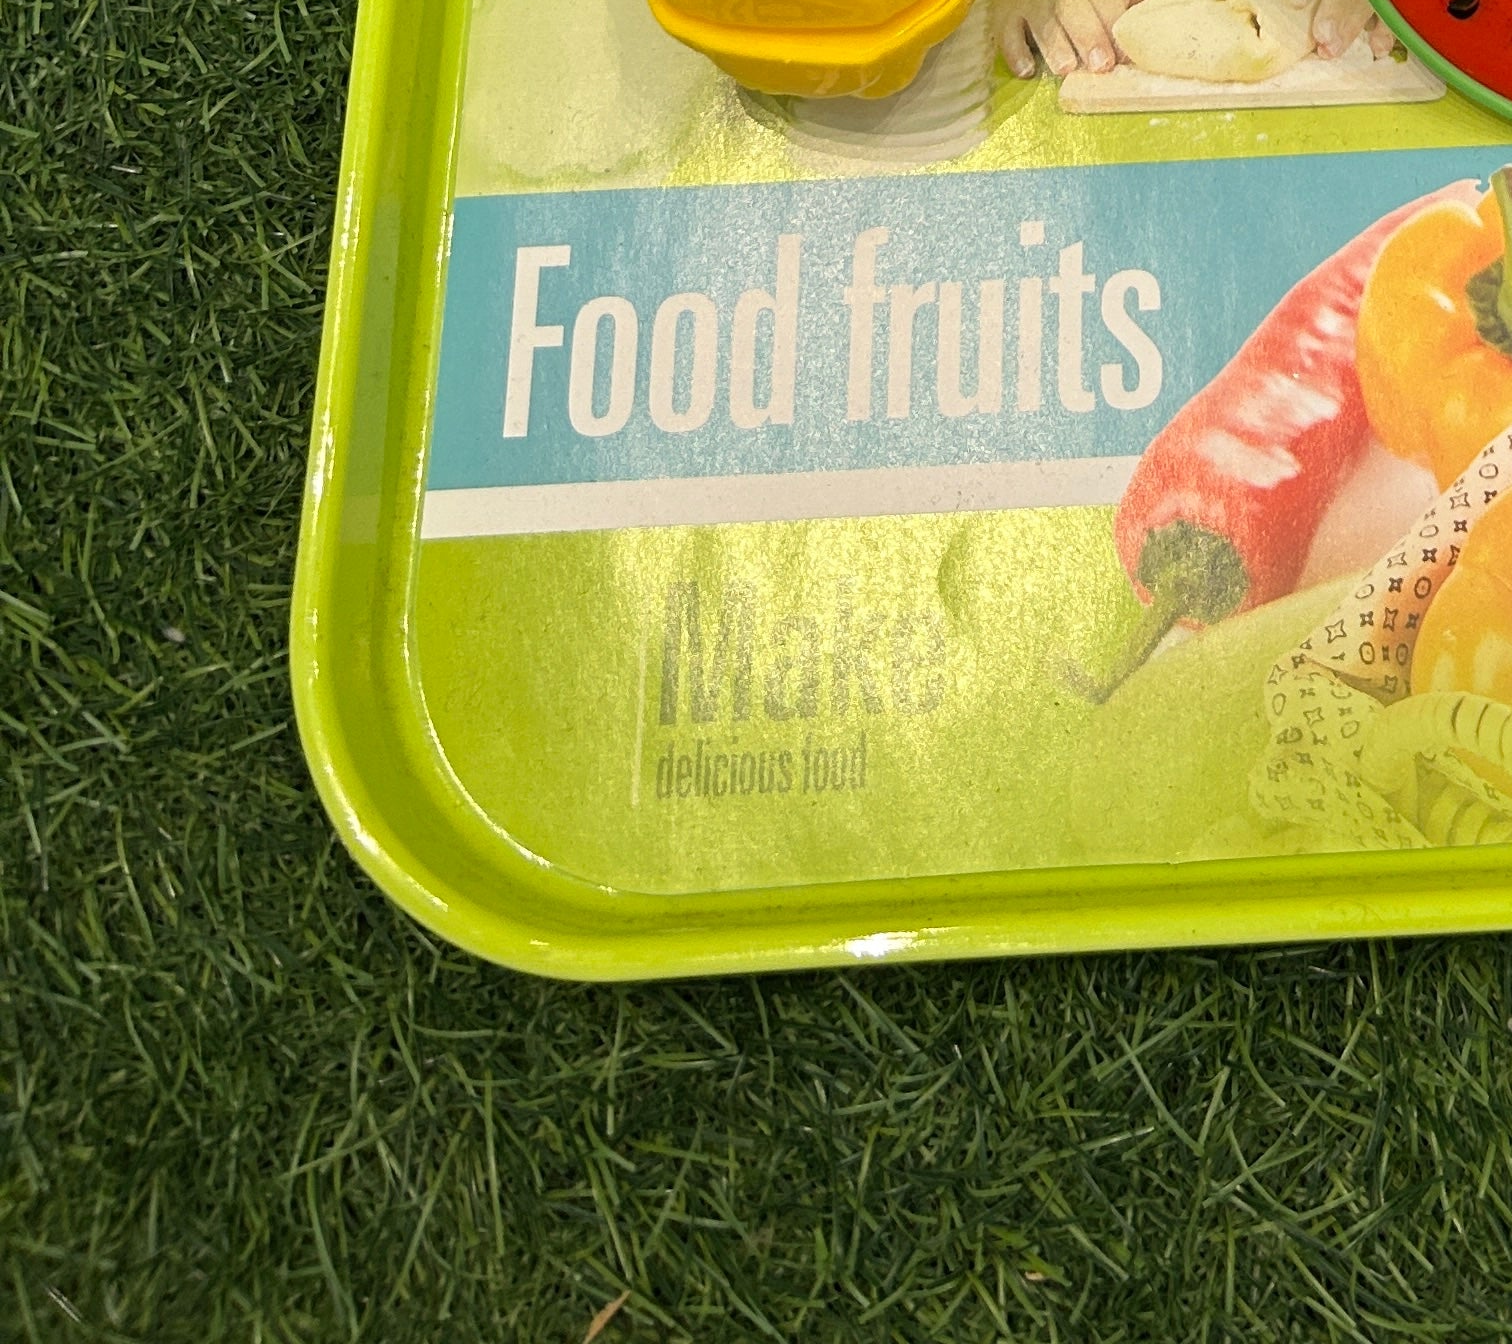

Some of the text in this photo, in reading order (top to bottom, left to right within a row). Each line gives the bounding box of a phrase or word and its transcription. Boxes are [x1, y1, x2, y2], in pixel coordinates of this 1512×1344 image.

[501, 219, 1165, 441] Food fruits
[655, 727, 868, 801] delicious food
